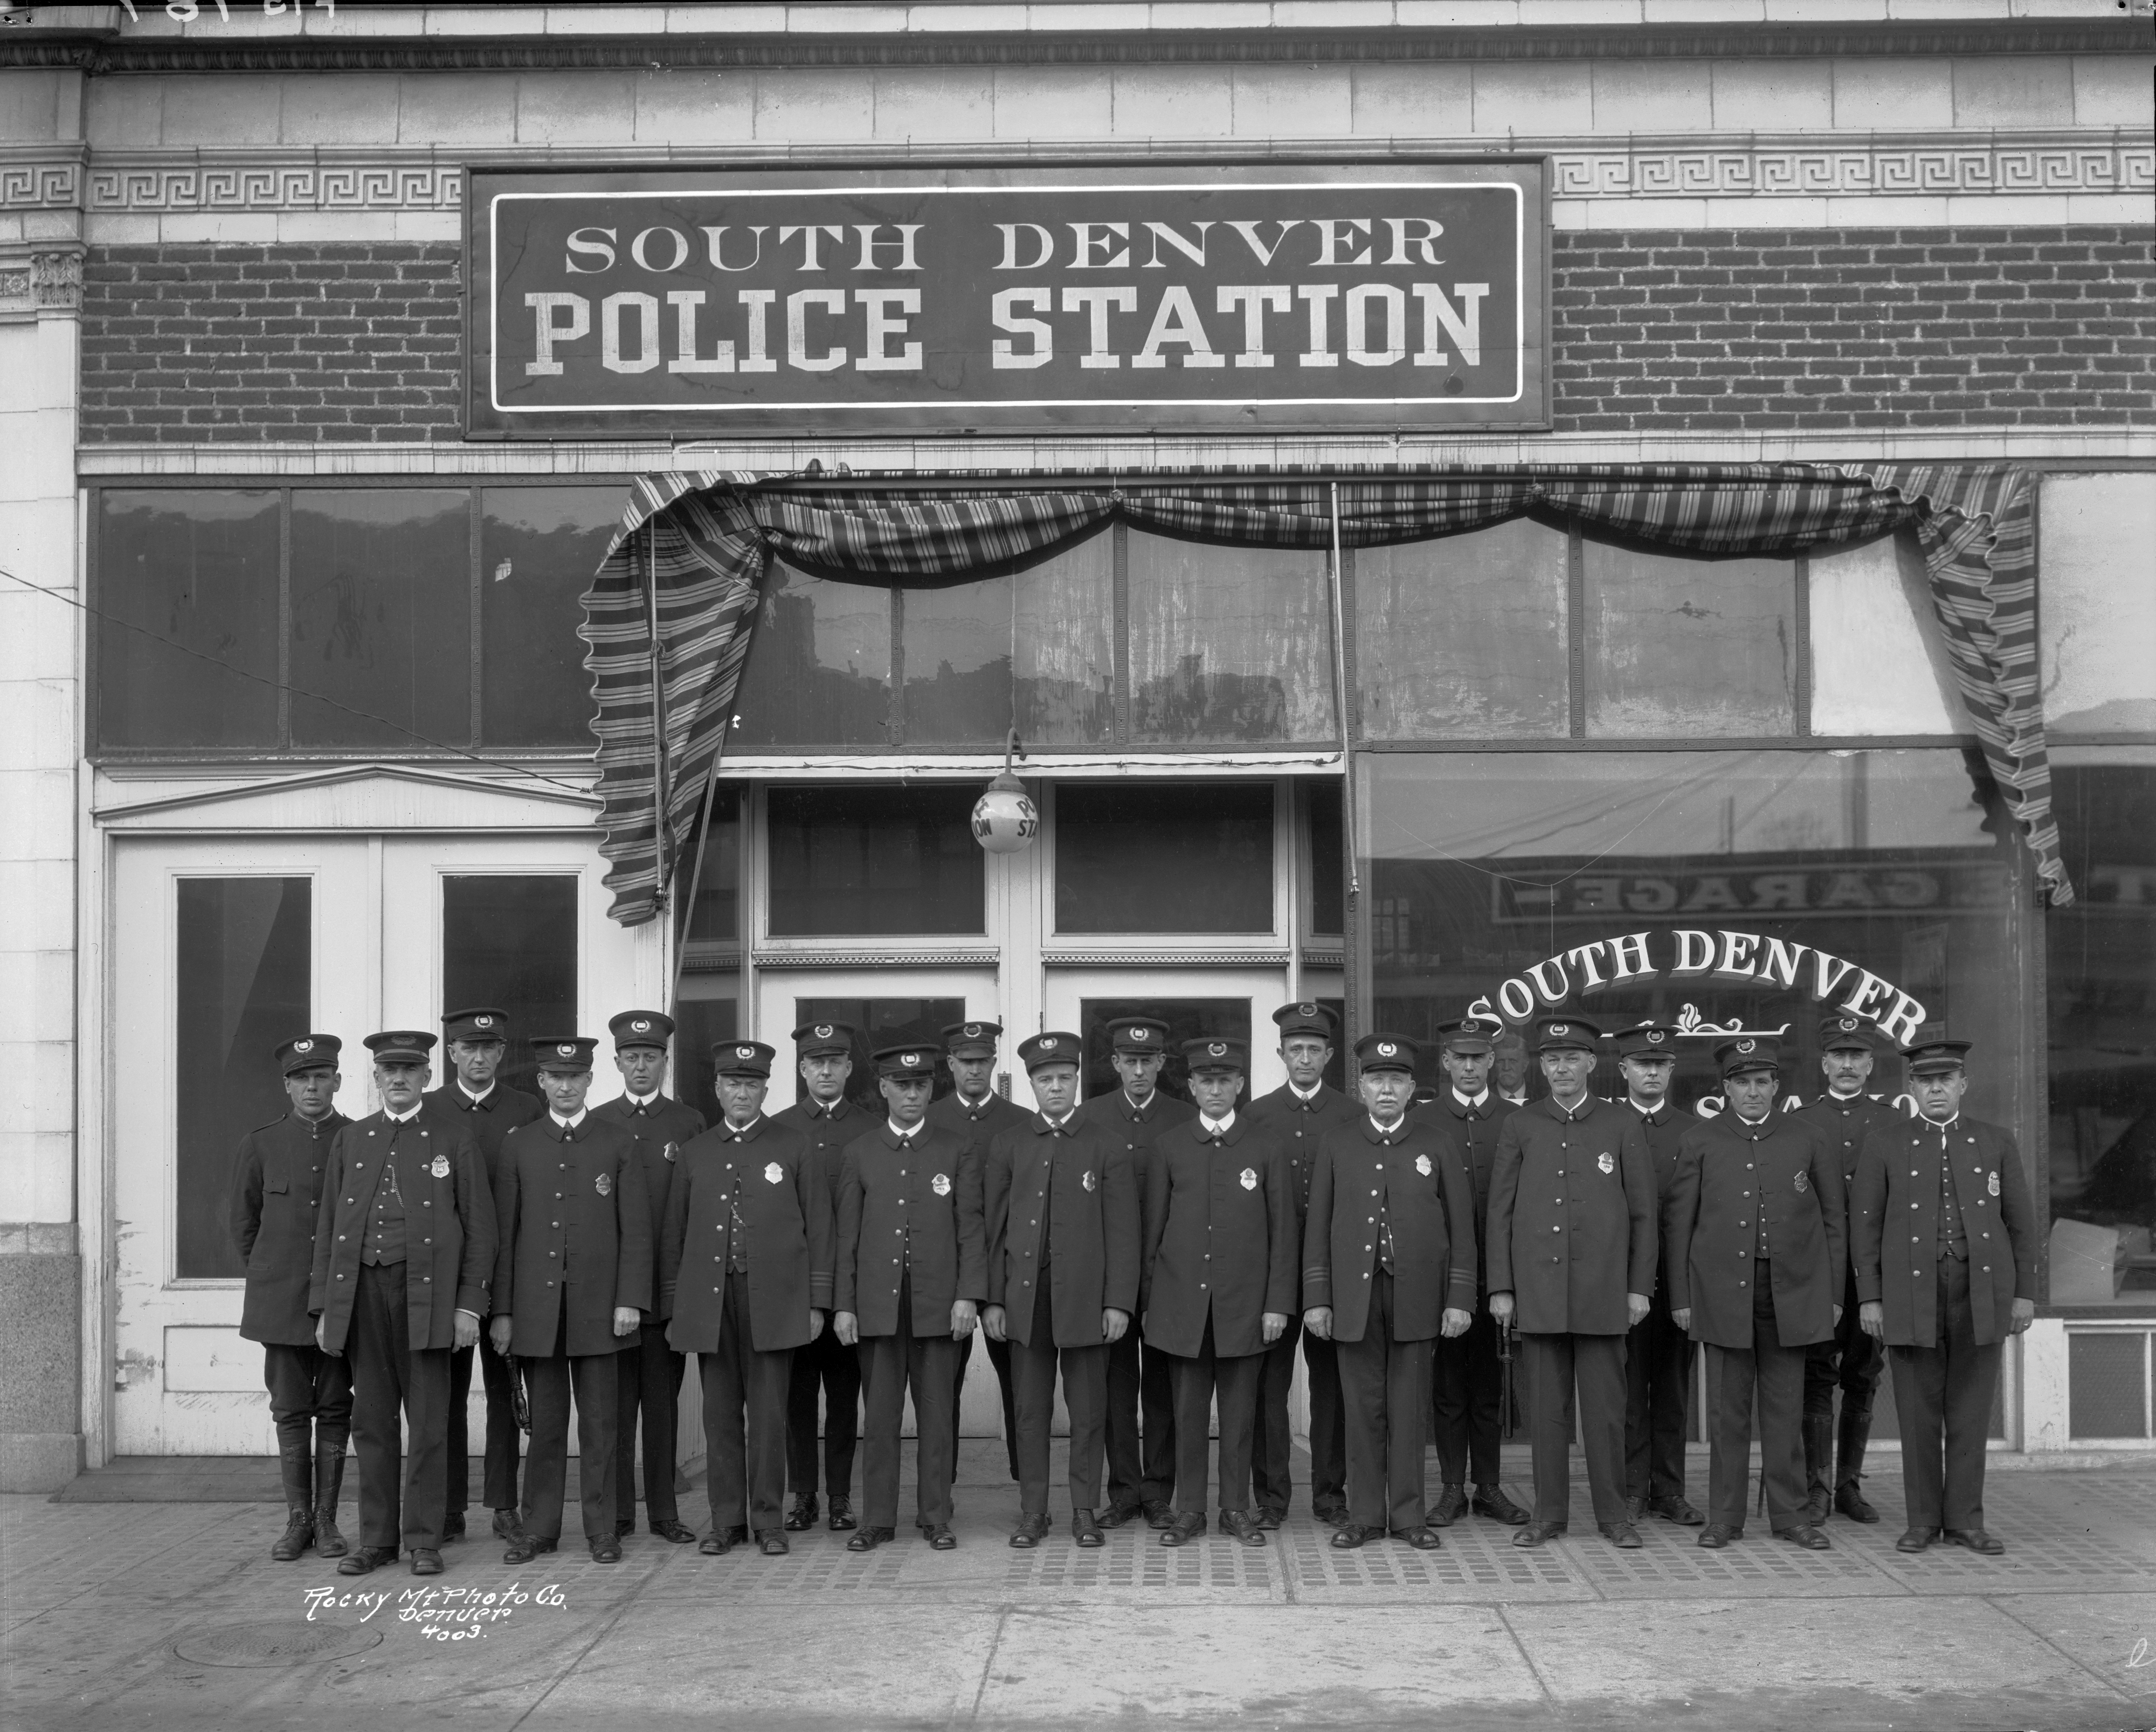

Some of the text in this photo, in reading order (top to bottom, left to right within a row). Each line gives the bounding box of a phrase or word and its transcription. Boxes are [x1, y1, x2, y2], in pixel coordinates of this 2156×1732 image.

[565, 217, 1447, 274] SOUTH DENVER
[524, 282, 1491, 376] POLICE STATION
[1467, 930, 1927, 1047] SOUTH DENVER
